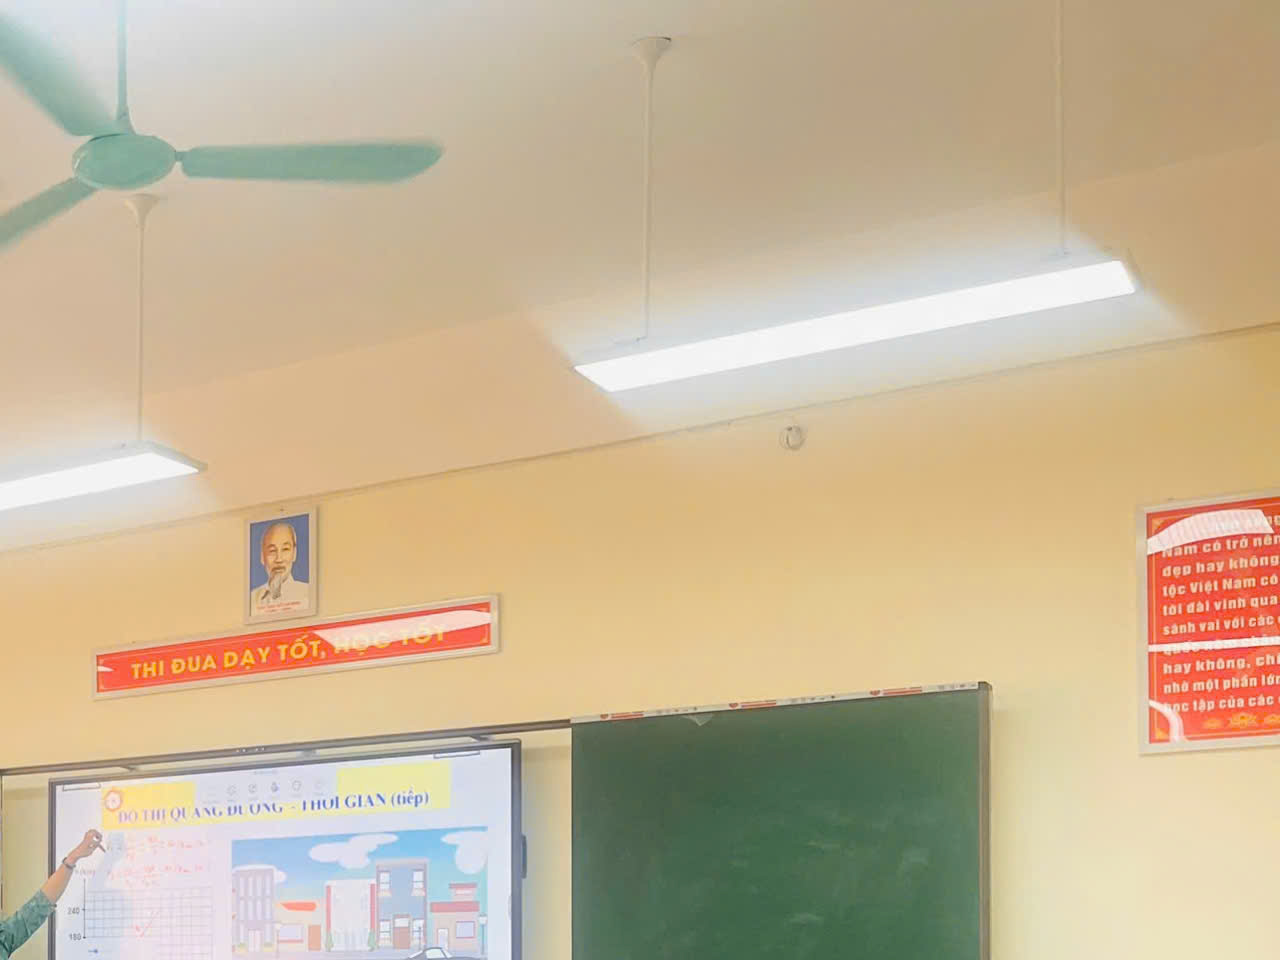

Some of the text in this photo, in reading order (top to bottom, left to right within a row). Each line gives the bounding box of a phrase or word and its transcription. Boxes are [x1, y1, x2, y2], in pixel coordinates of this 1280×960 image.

[1202, 541, 1221, 553] có
[1162, 565, 1191, 579] đẹp
[1196, 561, 1224, 574] hay
[1162, 574, 1278, 598] tộc Việt Nam có
[1214, 597, 1246, 611] vinh
[1250, 595, 1278, 608] qua
[1163, 614, 1274, 635] sánh vai với các
[131, 660, 165, 679] THI
[171, 655, 217, 675] ĐUA
[223, 646, 270, 670] DẠY
[277, 635, 326, 661] TỐT,
[1163, 663, 1191, 675] hay
[1193, 678, 1219, 692] một
[1193, 699, 1215, 713] tập
[1219, 695, 1244, 709] của
[1248, 693, 1274, 707] các
[345, 793, 386, 809] GIAN
[67, 907, 80, 915] 240
